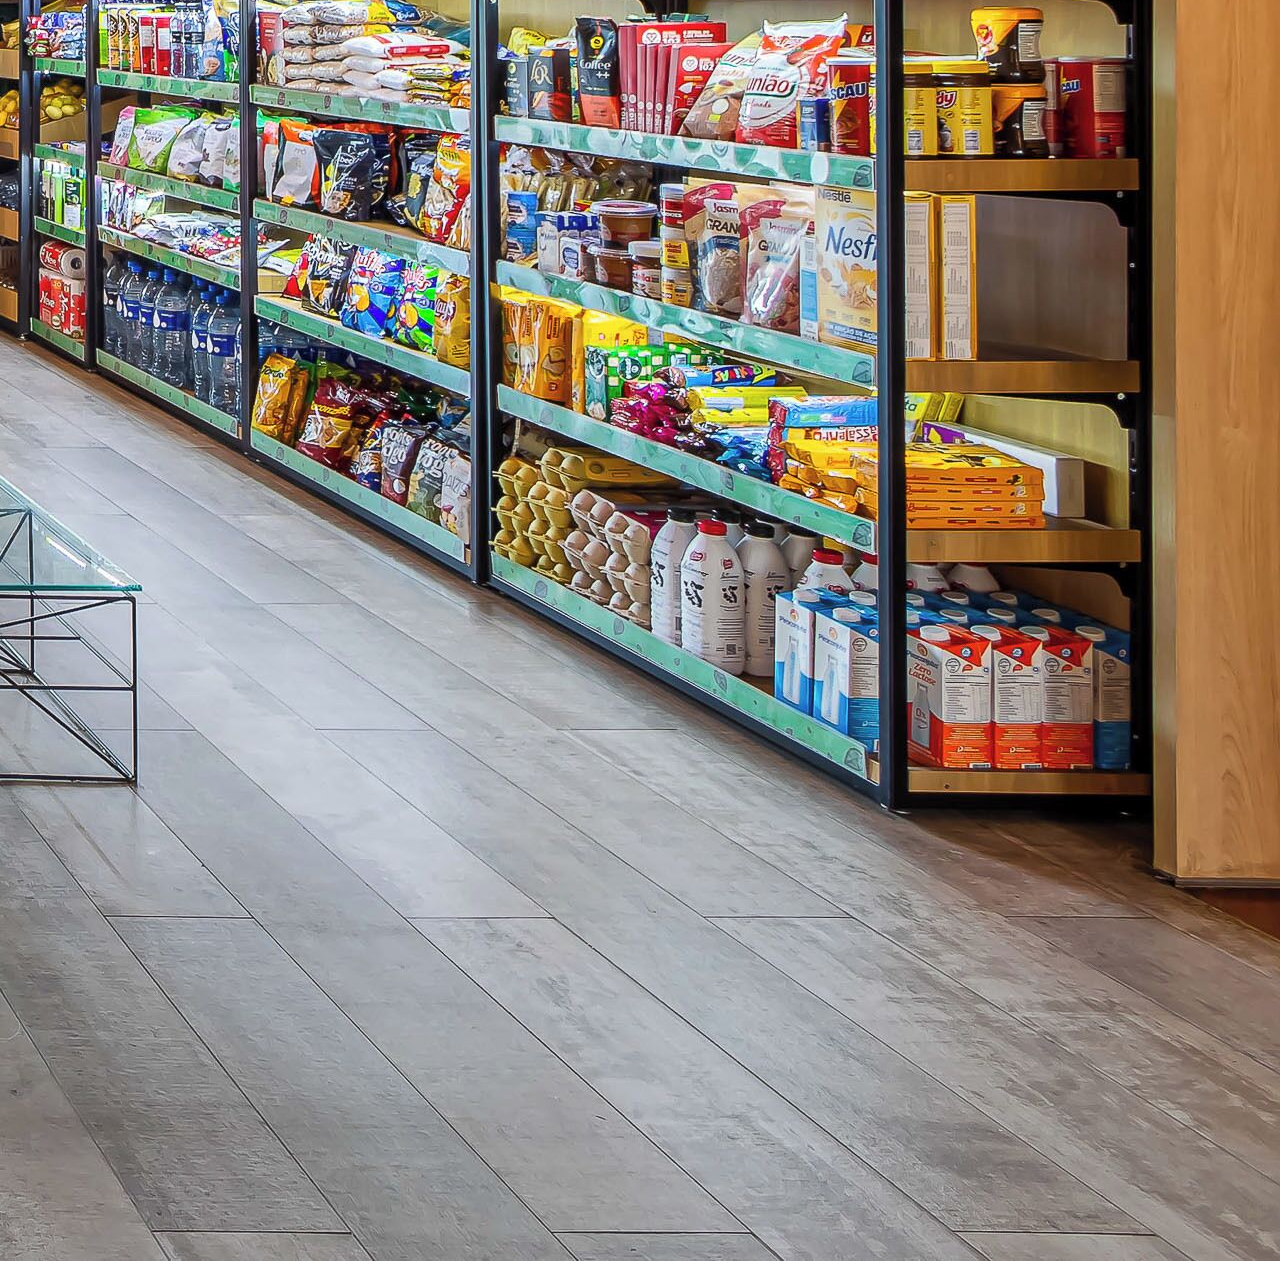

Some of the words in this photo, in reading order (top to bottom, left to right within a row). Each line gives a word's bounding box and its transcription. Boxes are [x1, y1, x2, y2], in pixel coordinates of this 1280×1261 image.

[579, 58, 612, 71] Coffee
[746, 75, 790, 94] união
[831, 82, 866, 100] SCAU
[713, 203, 739, 214] Jasm
[706, 218, 741, 234] GRAN
[825, 226, 877, 261] Nesf
[908, 668, 937, 687] Lactose
[913, 663, 932, 677] Zero
